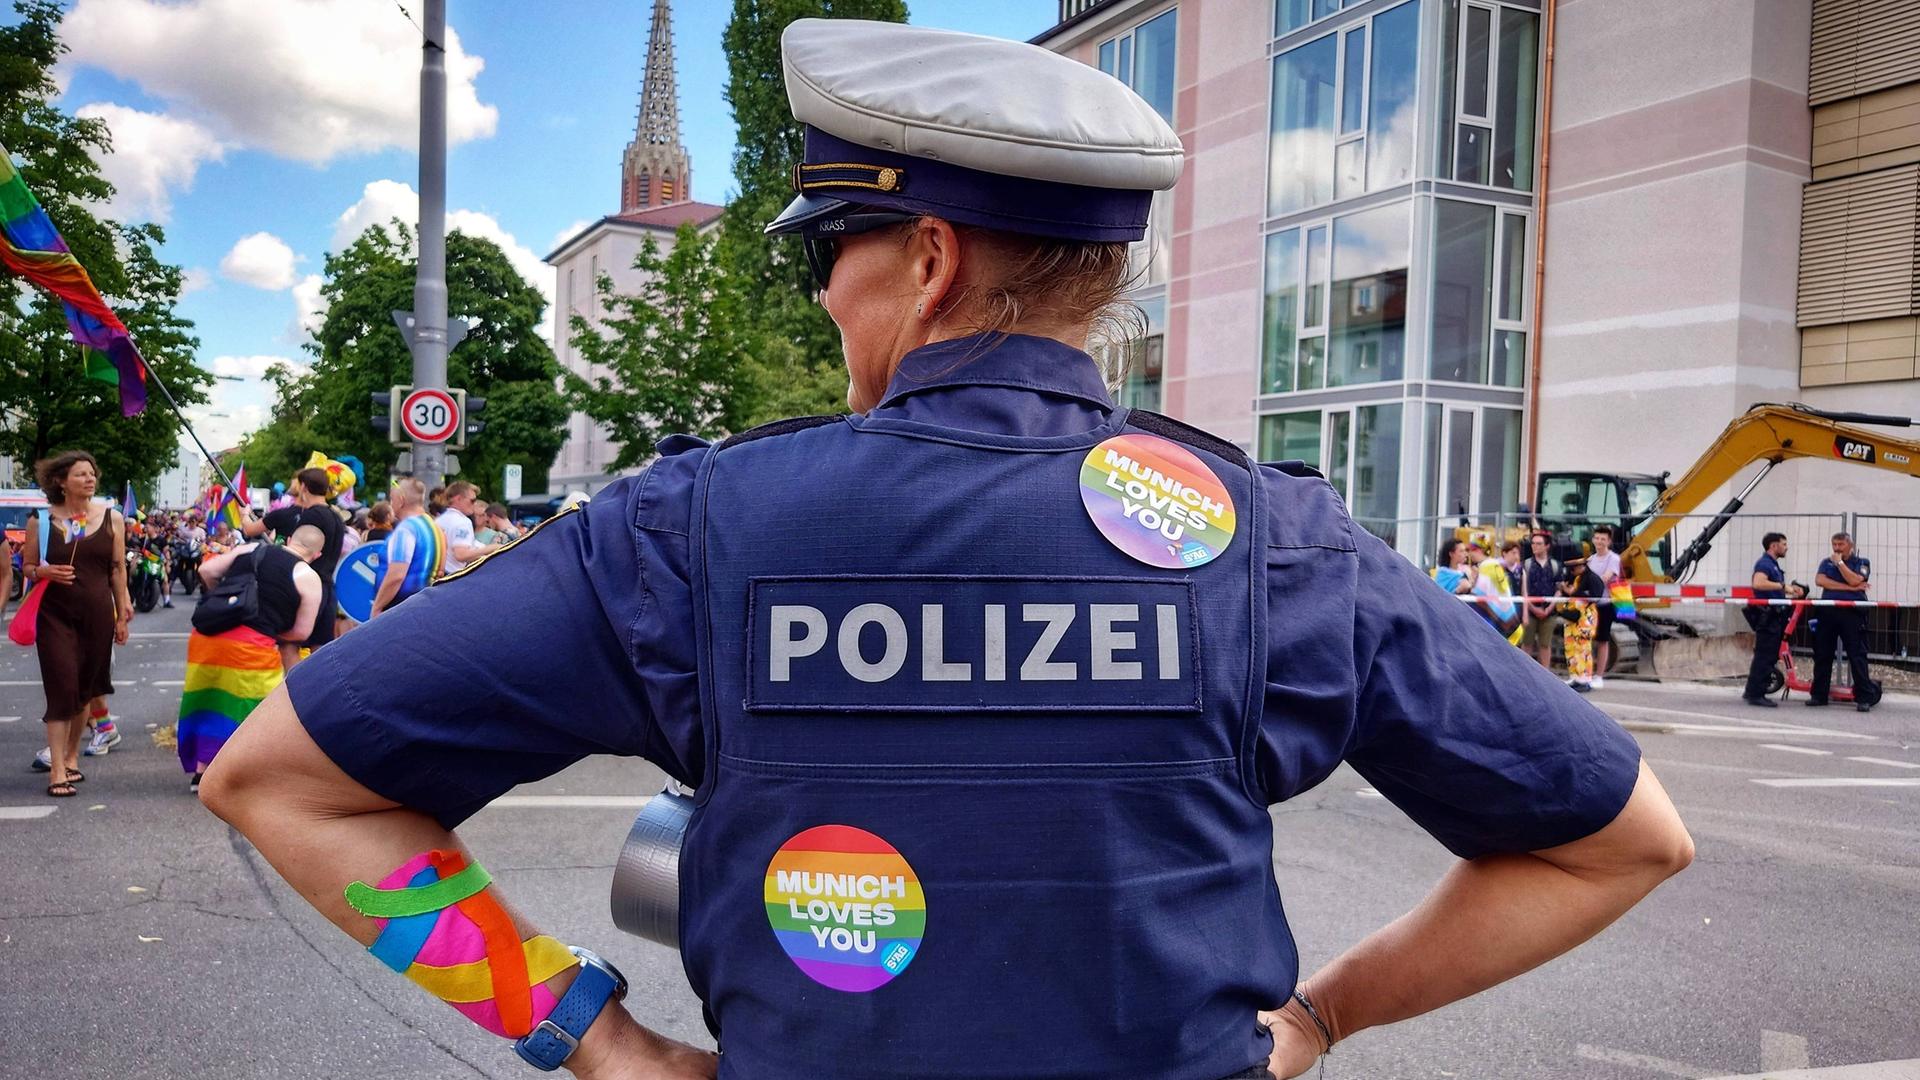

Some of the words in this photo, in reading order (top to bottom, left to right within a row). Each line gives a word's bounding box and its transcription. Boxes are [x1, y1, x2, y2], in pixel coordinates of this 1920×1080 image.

[819, 219, 846, 232] KRASS
[414, 403, 446, 427] 30
[1843, 441, 1871, 461] CAT
[1104, 448, 1225, 519] MUNICH
[1105, 471, 1208, 531] LOVES
[1121, 496, 1185, 541] YOU
[769, 603, 1180, 683] POLIZEI
[776, 870, 906, 899] MUNICH
[789, 898, 896, 926] LOVES
[810, 925, 876, 954] YOU
